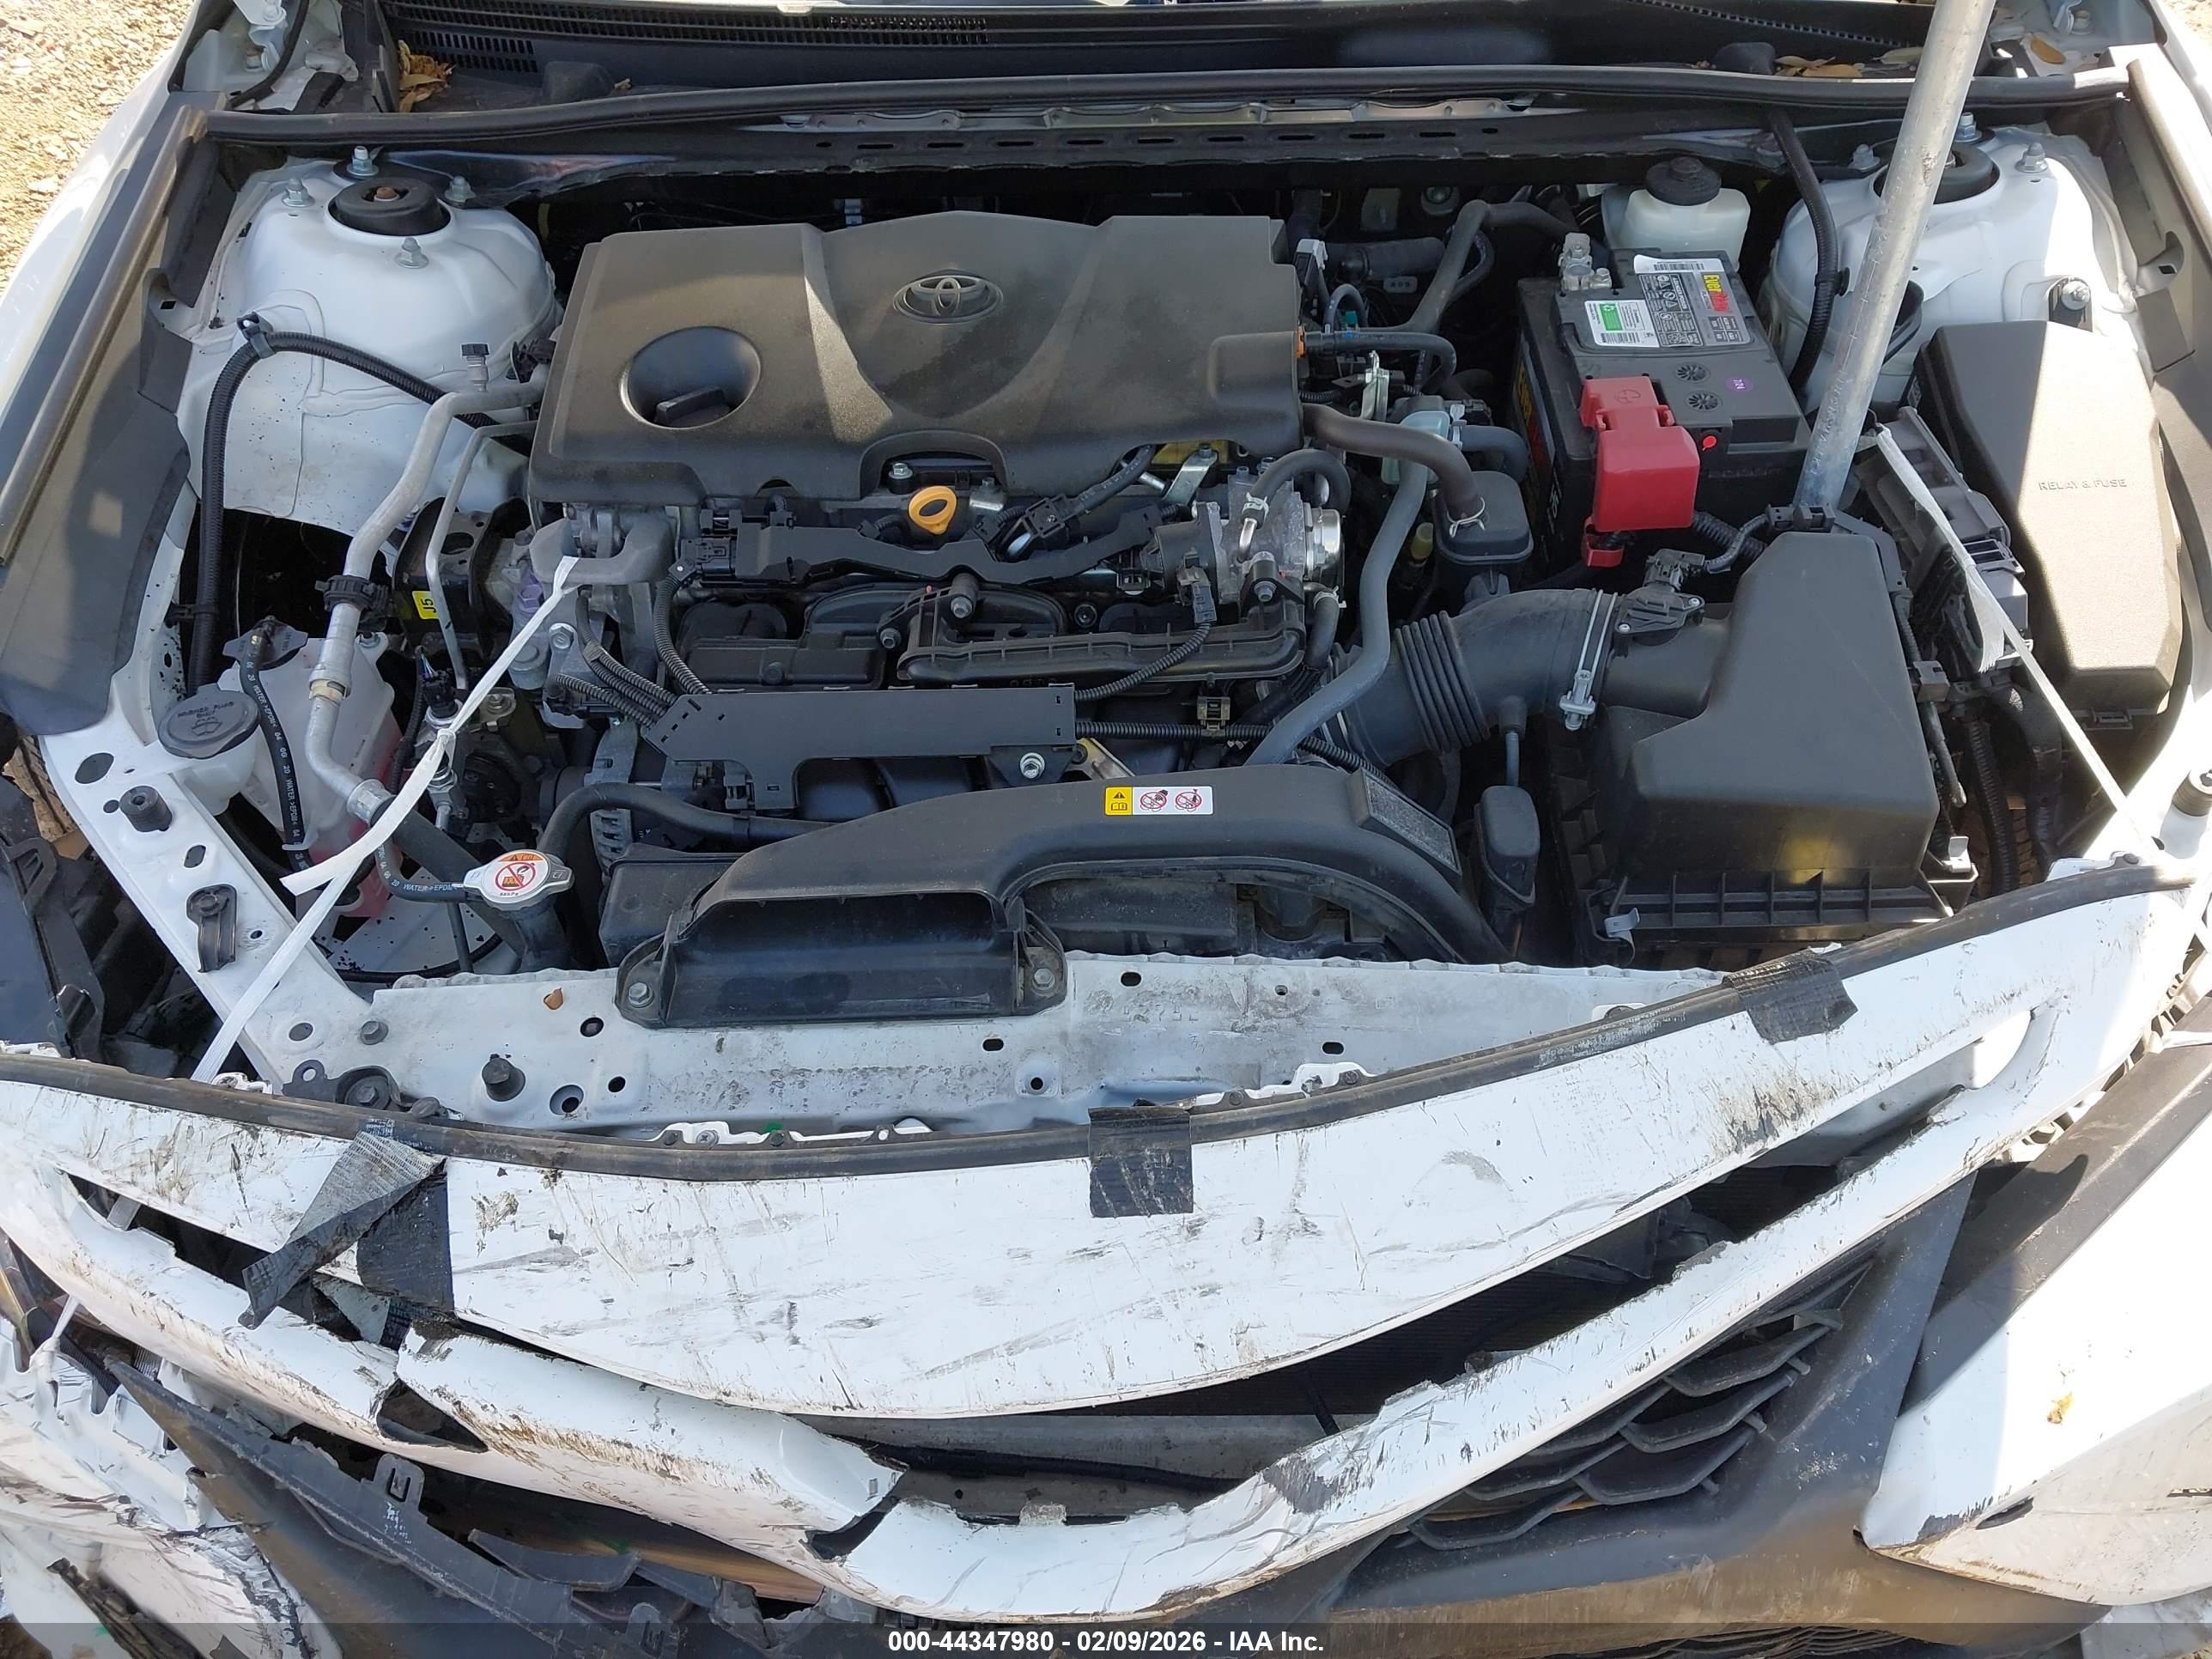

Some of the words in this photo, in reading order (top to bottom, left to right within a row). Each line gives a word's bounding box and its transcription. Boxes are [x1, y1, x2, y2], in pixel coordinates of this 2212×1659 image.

[2039, 480, 2078, 490] RELAY
[2081, 480, 2092, 489] &
[2094, 479, 2128, 488] FUSE
[420, 598, 437, 613] J5
[253, 684, 267, 704] WATER
[283, 765, 291, 774] 20
[286, 779, 295, 802] WATER
[403, 883, 428, 892] WATER
